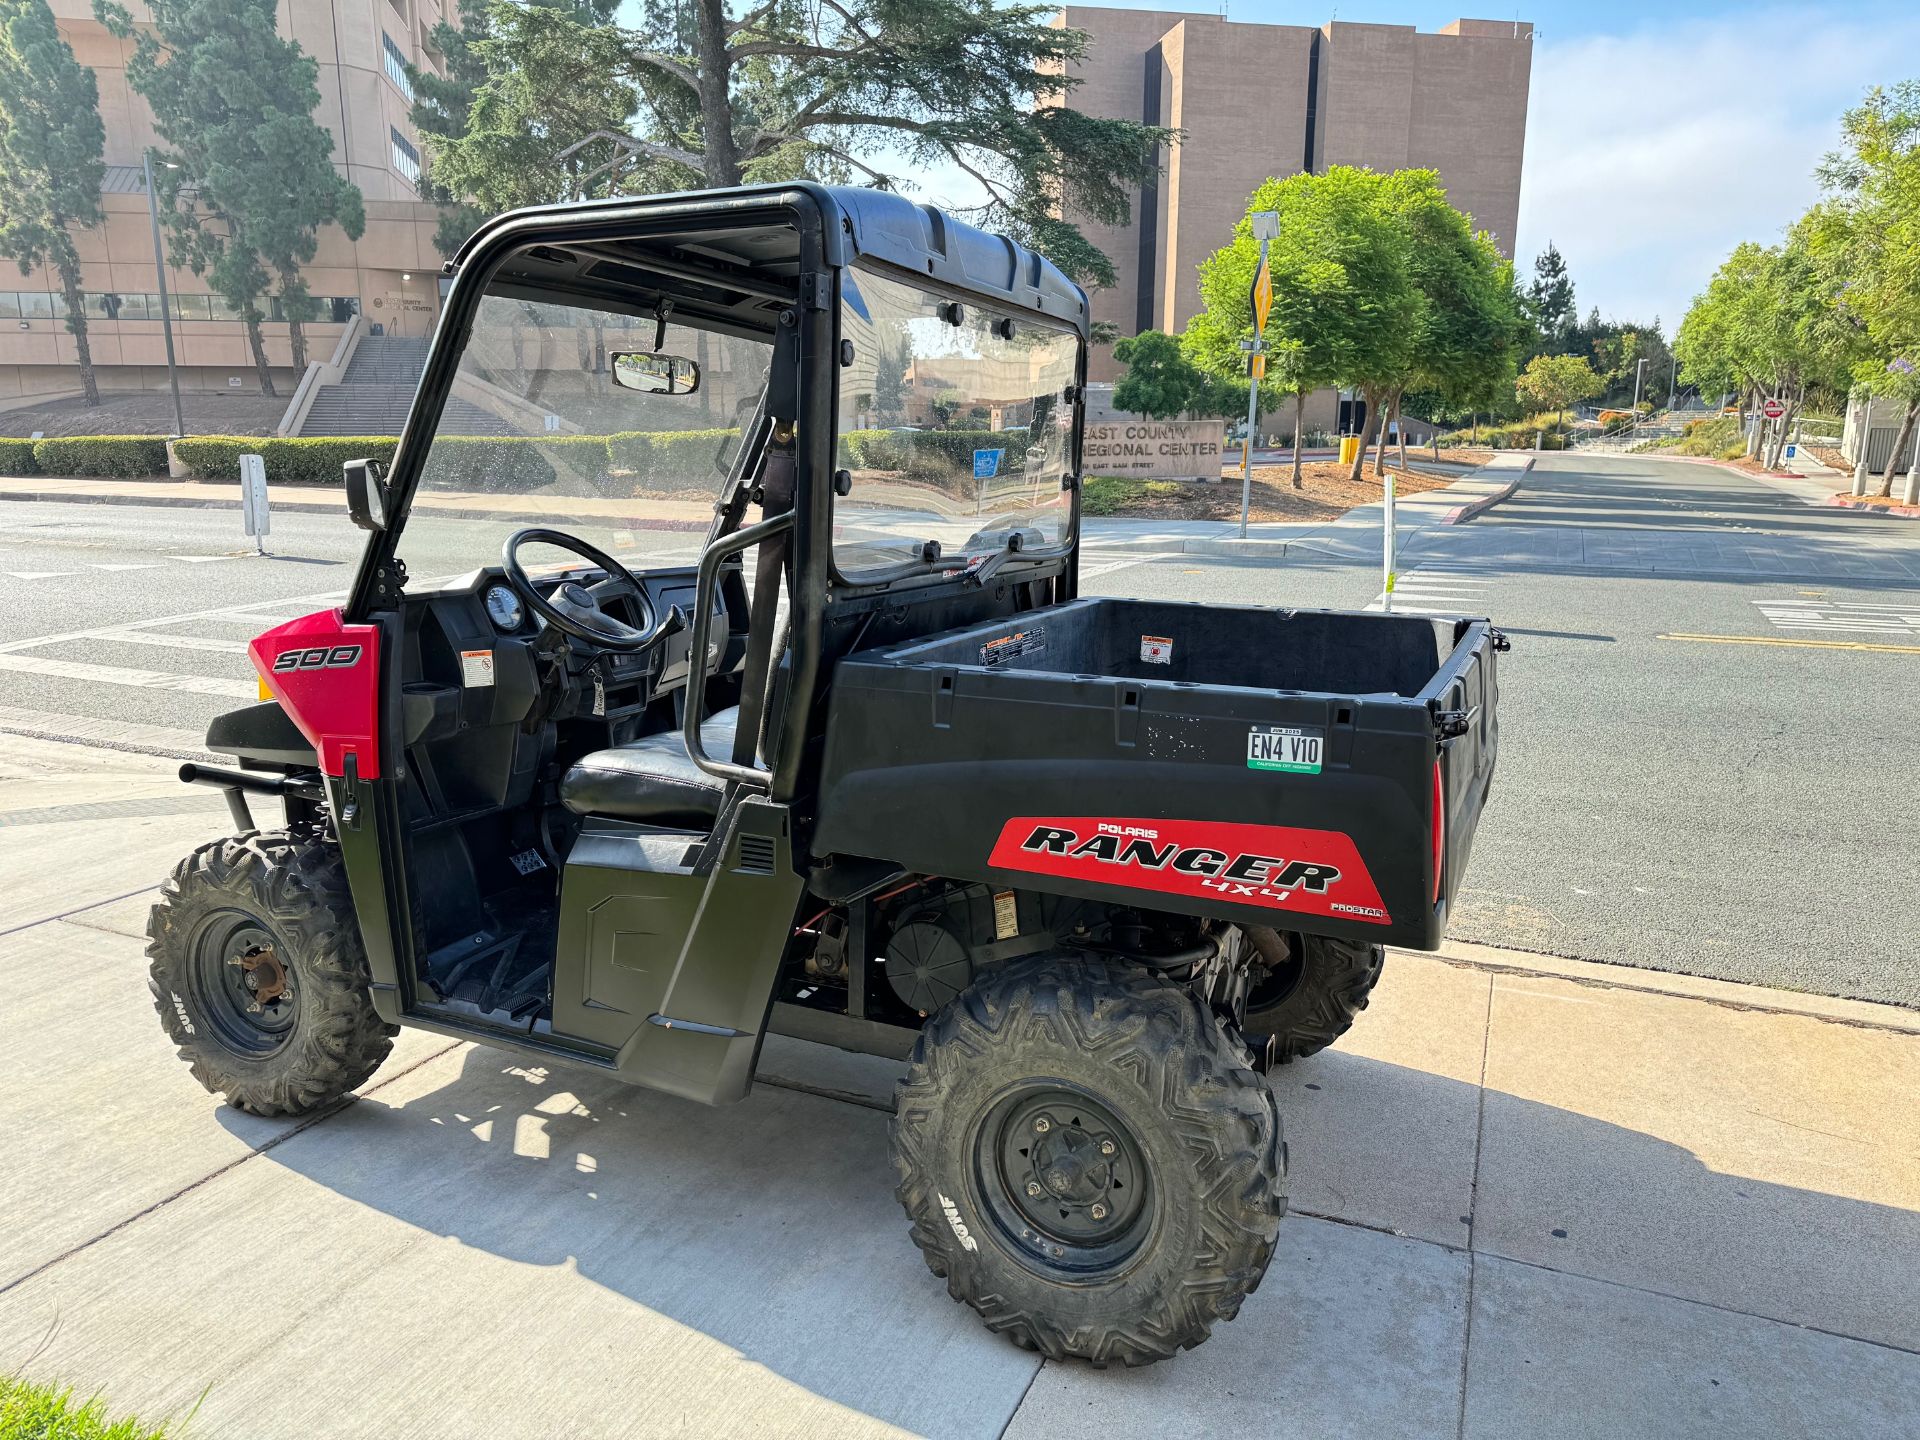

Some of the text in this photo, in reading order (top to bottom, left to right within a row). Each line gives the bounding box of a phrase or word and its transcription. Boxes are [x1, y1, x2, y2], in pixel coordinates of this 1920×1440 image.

[1126, 426, 1188, 440] COUNTY
[1159, 442, 1218, 456] CENTER
[272, 644, 363, 673] 500
[1251, 734, 1318, 763] EN4 V10
[1098, 823, 1158, 839] POLARIS
[1020, 825, 1343, 894] RANGER
[1330, 903, 1383, 918] PROSTAR
[170, 990, 195, 1035] SUNF
[937, 1192, 978, 1252] SUNF
